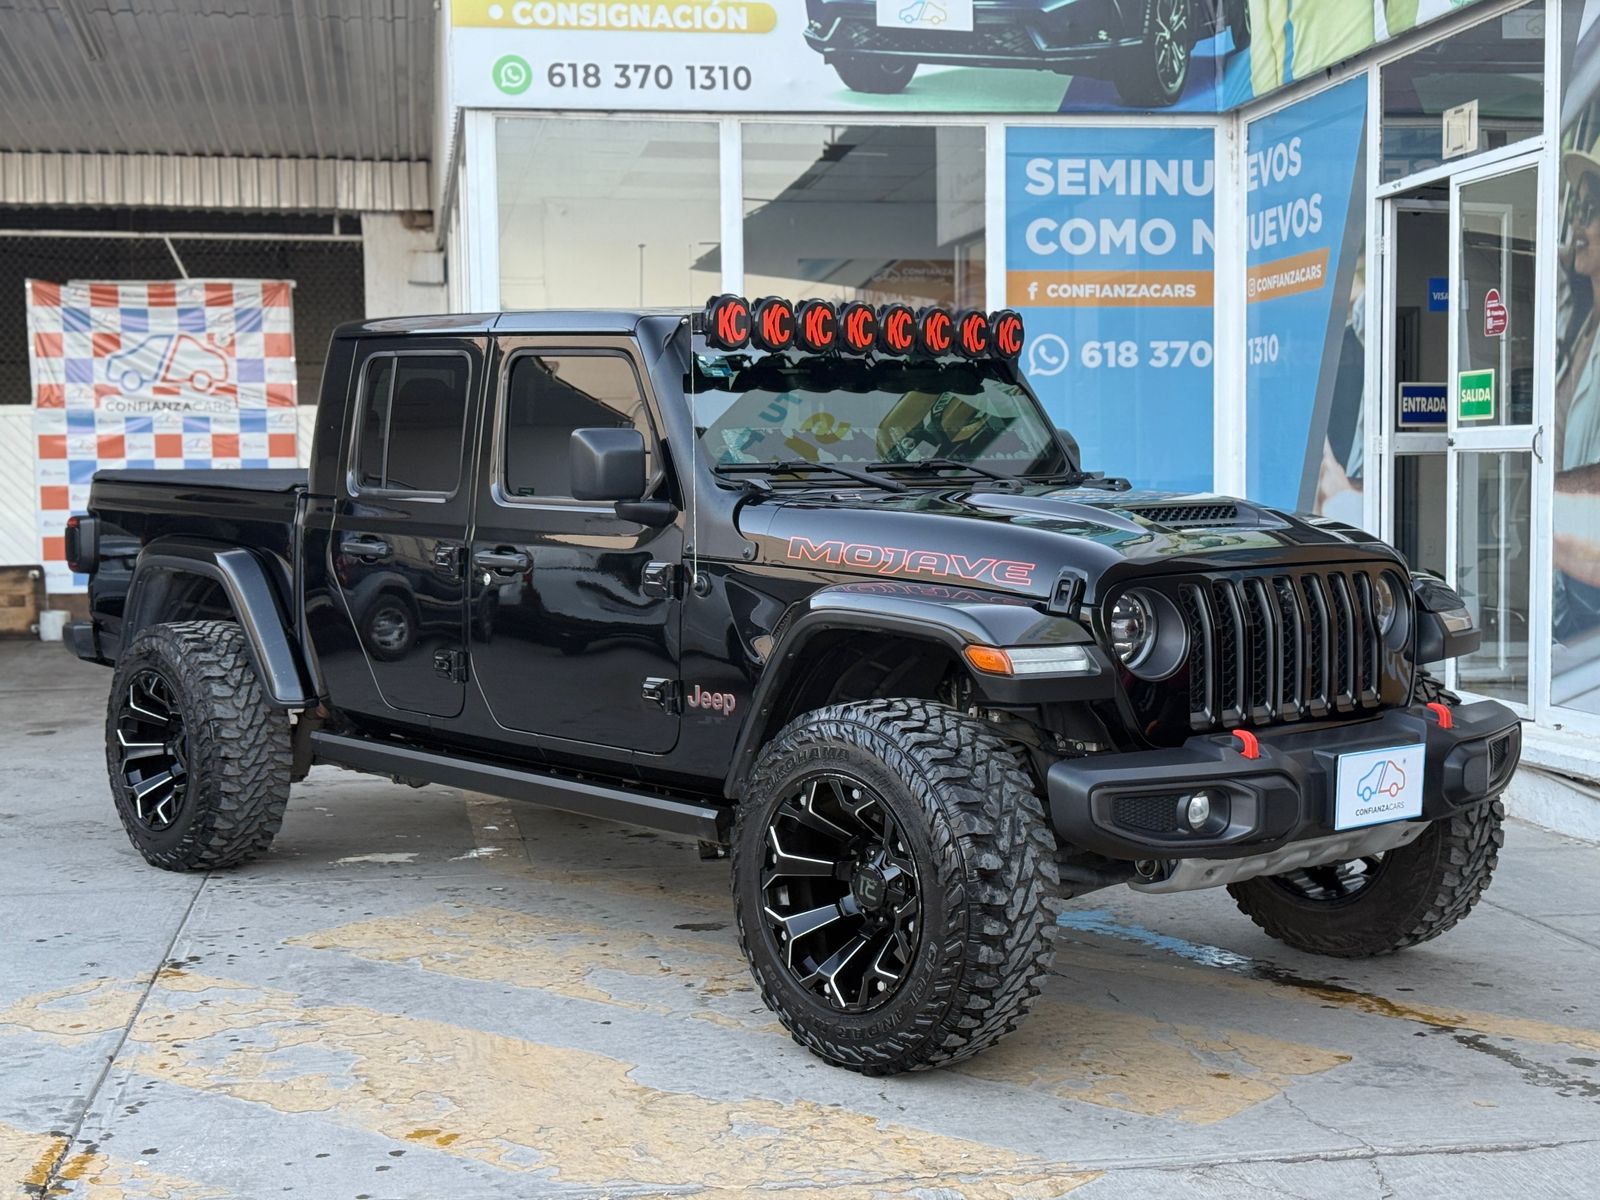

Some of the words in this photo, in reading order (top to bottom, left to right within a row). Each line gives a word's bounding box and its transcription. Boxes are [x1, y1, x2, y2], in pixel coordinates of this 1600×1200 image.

[512, 0, 748, 30] CONSIGNACIÓN
[547, 62, 602, 89] 618
[614, 64, 674, 90] 370
[685, 65, 752, 91] 1310
[1025, 217, 1176, 256] COMO
[1046, 283, 1197, 298] CONFIANZACARS
[1256, 263, 1322, 293] CONFIANZACARS
[1432, 292, 1449, 301] VISA
[718, 301, 747, 344] KC
[763, 304, 790, 345] KC
[806, 306, 832, 347] KC
[847, 307, 873, 348] KC
[888, 310, 912, 349] KC
[926, 312, 950, 351] KC
[963, 314, 986, 353] KC
[999, 316, 1021, 354] KC
[1081, 341, 1139, 369] 618
[1149, 340, 1213, 369] 370
[1248, 333, 1279, 365] 1310
[105, 400, 232, 412] CONFIANZACARS
[1402, 396, 1447, 413] ENTRADA
[1461, 388, 1491, 404] SALIDA
[787, 536, 1035, 585] MOJAVE
[687, 684, 736, 716] Jeep
[1355, 801, 1405, 816] CONFIANZACARS
